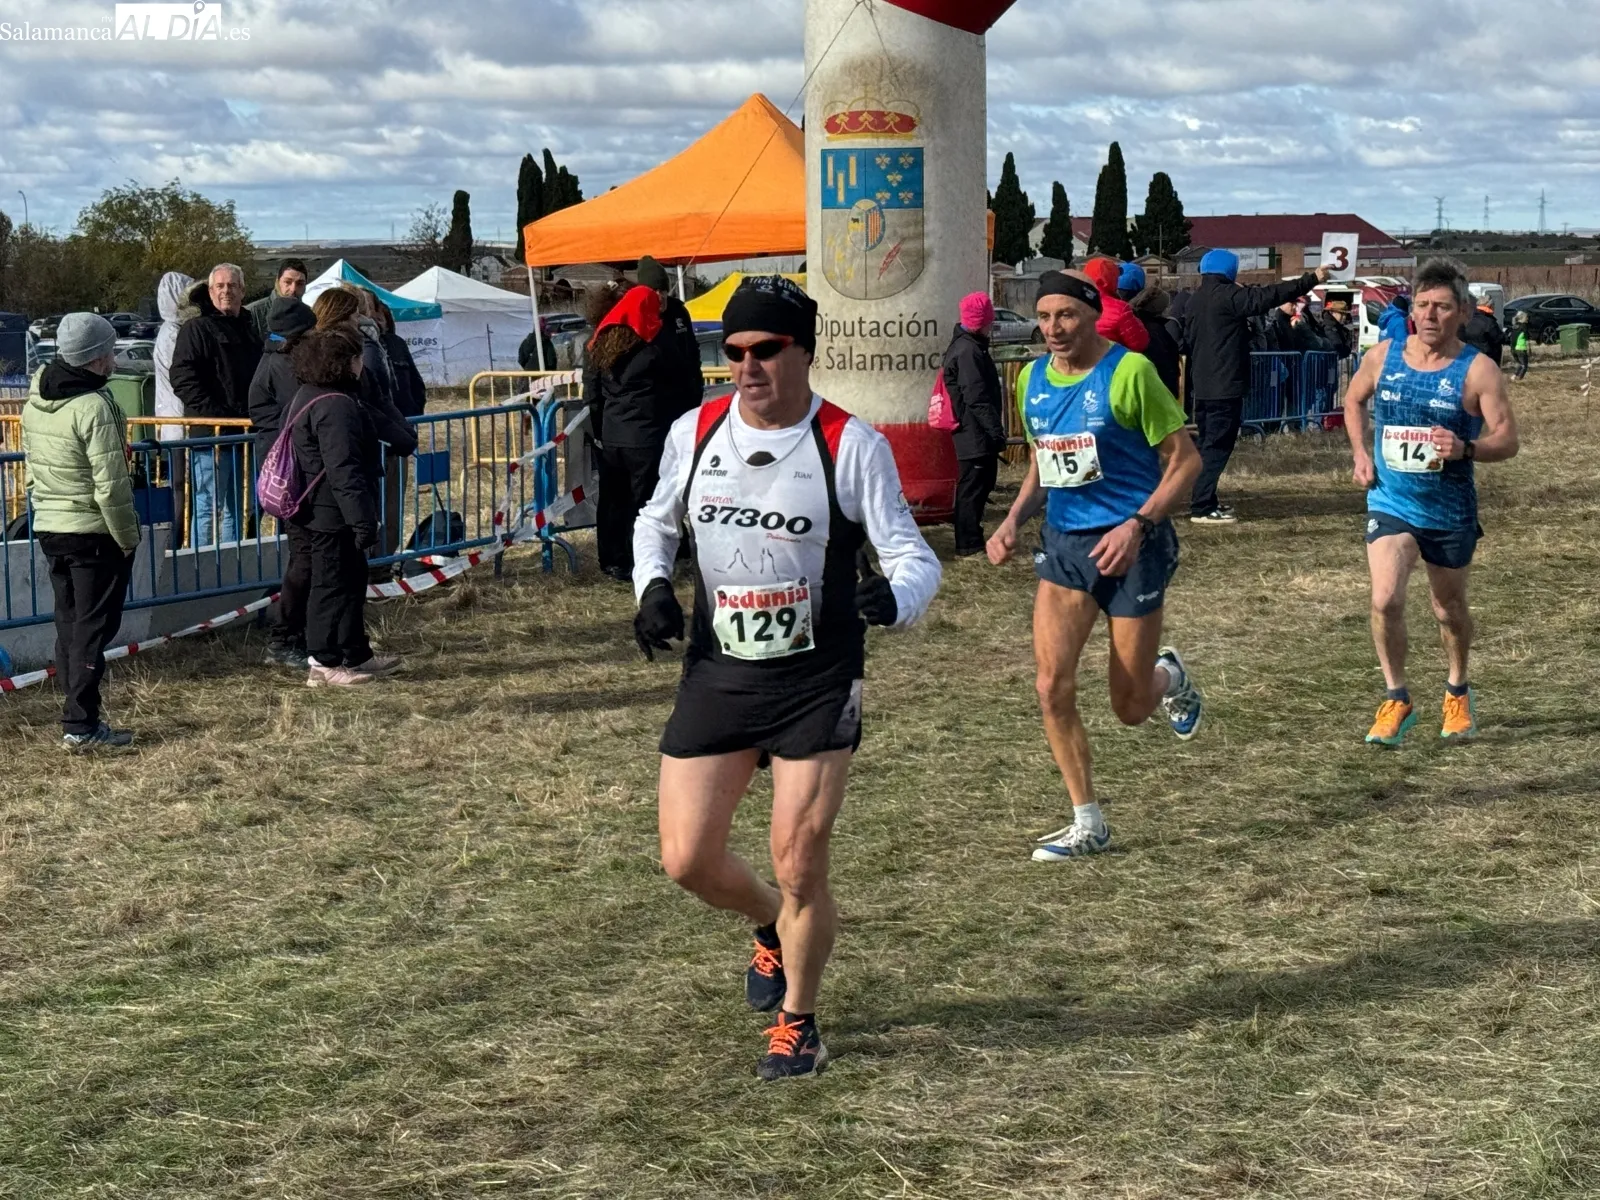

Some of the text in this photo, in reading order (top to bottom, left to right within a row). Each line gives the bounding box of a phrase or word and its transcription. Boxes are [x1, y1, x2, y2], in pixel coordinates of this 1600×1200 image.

[1329, 246, 1349, 272] 3
[826, 345, 944, 371] Salamanc
[1384, 428, 1434, 442] beduni
[1052, 451, 1079, 475] 15
[1399, 441, 1426, 462] 14
[701, 469, 728, 477] VIATOR
[697, 504, 813, 535] 37300
[730, 606, 797, 643] 129
